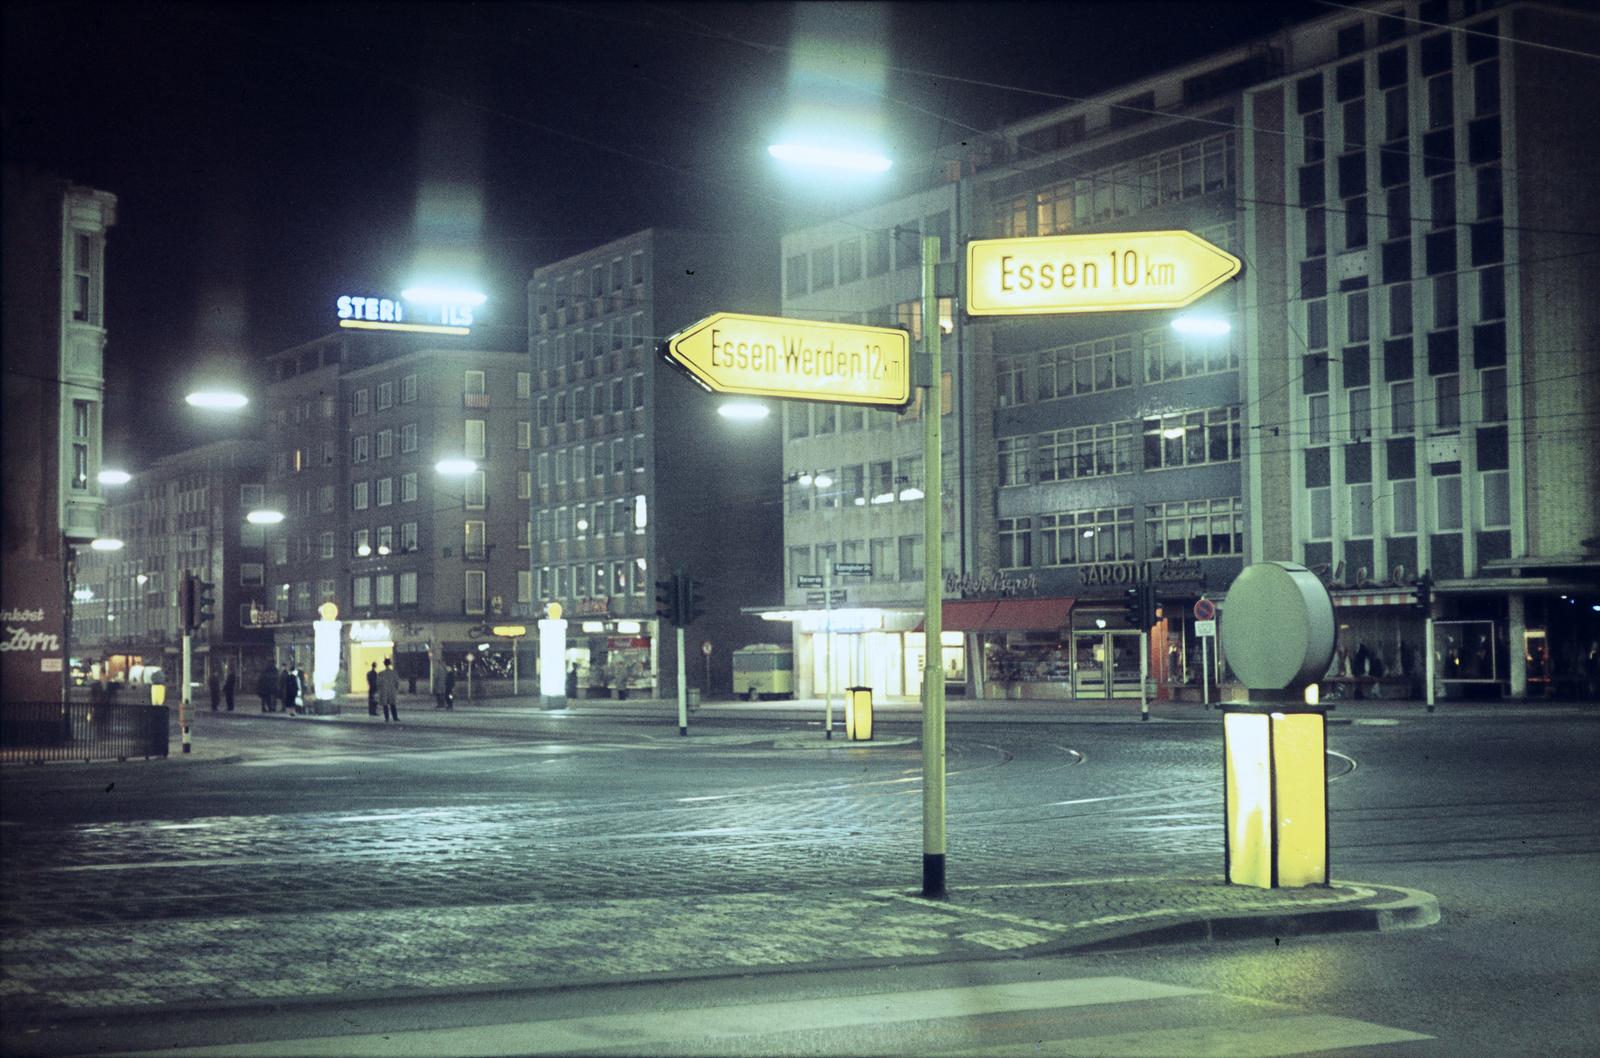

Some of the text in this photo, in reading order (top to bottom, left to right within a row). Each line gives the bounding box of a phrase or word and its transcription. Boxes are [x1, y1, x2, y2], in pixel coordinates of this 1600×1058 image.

[1001, 249, 1176, 291] Essen 10 km
[711, 328, 863, 379] Essen-Werden
[864, 344, 882, 380] 12
[0, 625, 60, 651] Zorn
